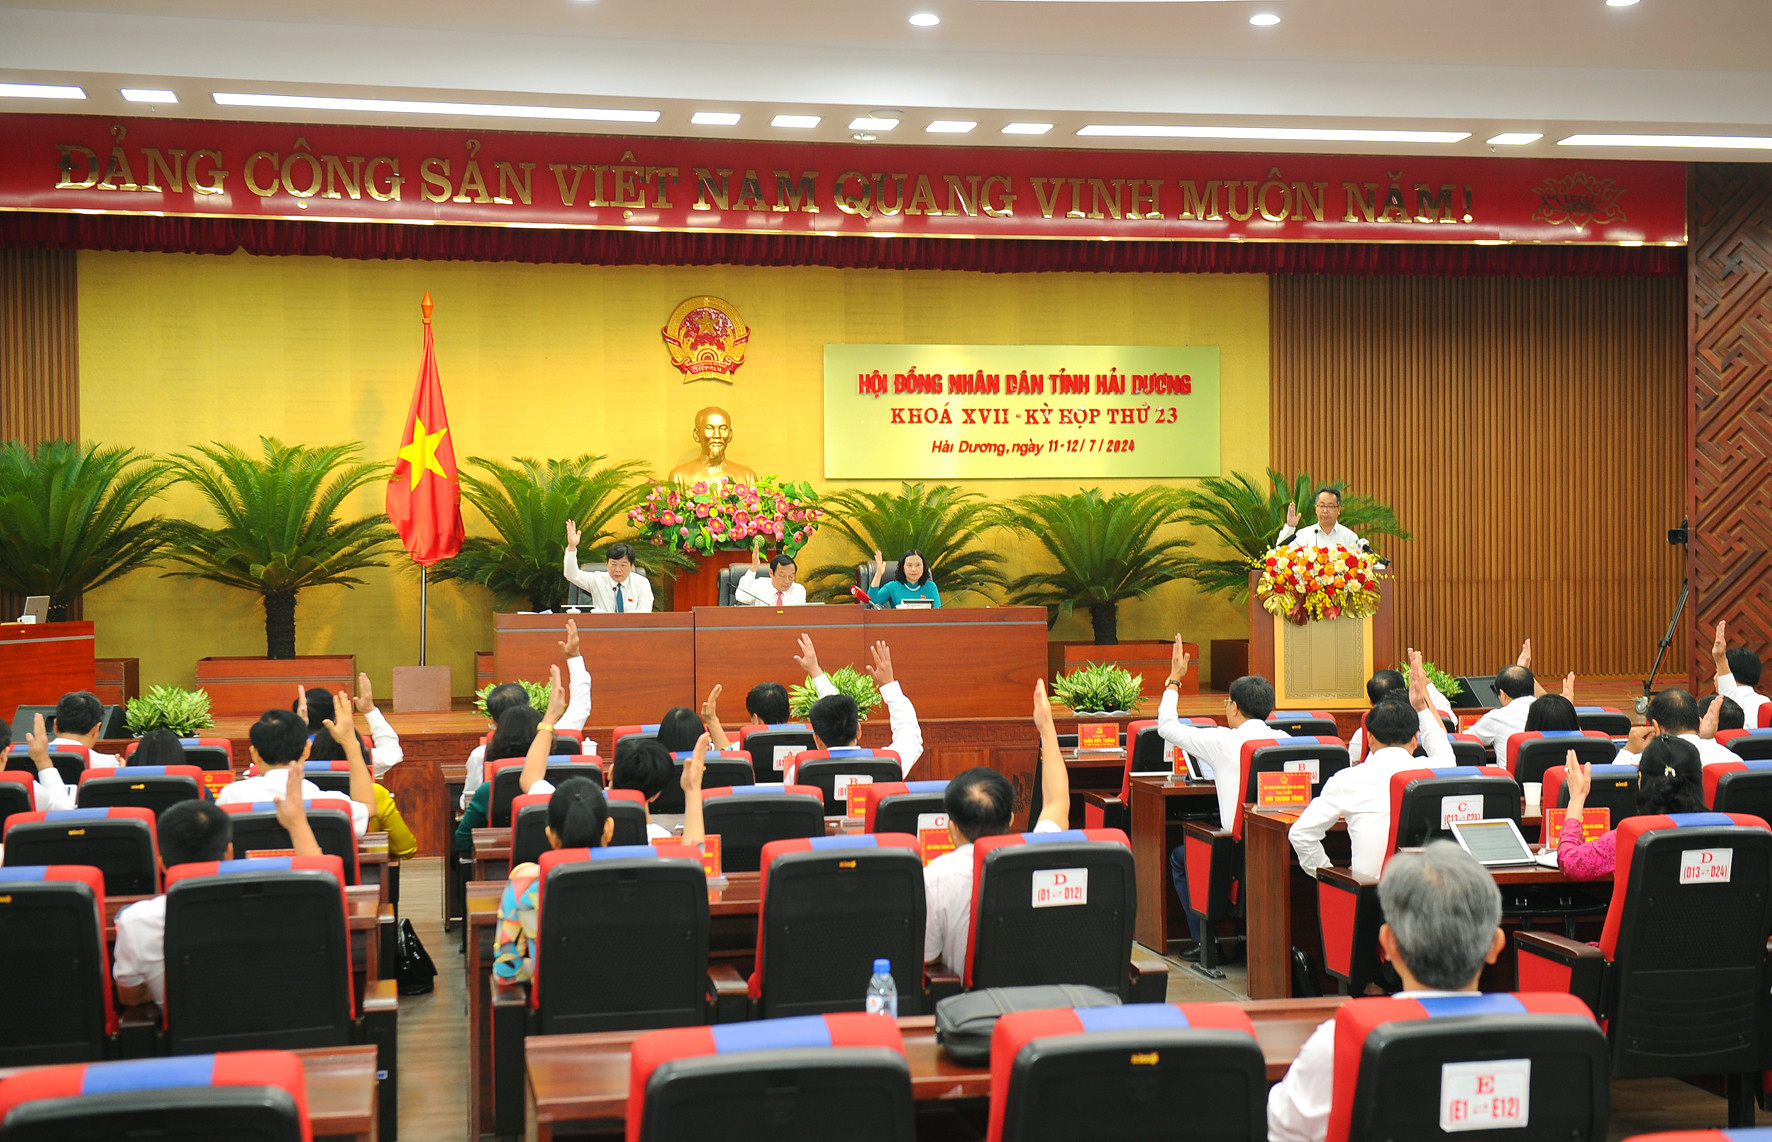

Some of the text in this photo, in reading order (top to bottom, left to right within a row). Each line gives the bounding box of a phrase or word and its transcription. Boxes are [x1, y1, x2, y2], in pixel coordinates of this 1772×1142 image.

[55, 125, 1474, 224] ĐẢNG CỘNG SẢN VIỆT NAM QUANG VINH MUÔN NĂM!
[858, 366, 1192, 398] HỘI ĐỒNG NHÂN DÂN TỈNH HẢI DƯƠNG
[890, 402, 952, 424] KHOÁ
[962, 408, 1009, 424] XVII
[1025, 402, 1053, 424] KỲ
[1059, 408, 1100, 429] HỌP
[1107, 402, 1150, 424] THỨ
[1155, 407, 1178, 424] 23
[932, 439, 954, 453] Hải
[1298, 763, 1306, 771] B
[1458, 802, 1467, 813] C
[934, 816, 944, 827] C
[1701, 852, 1713, 864] D
[1054, 873, 1067, 886] D
[1476, 1075, 1495, 1095] E
